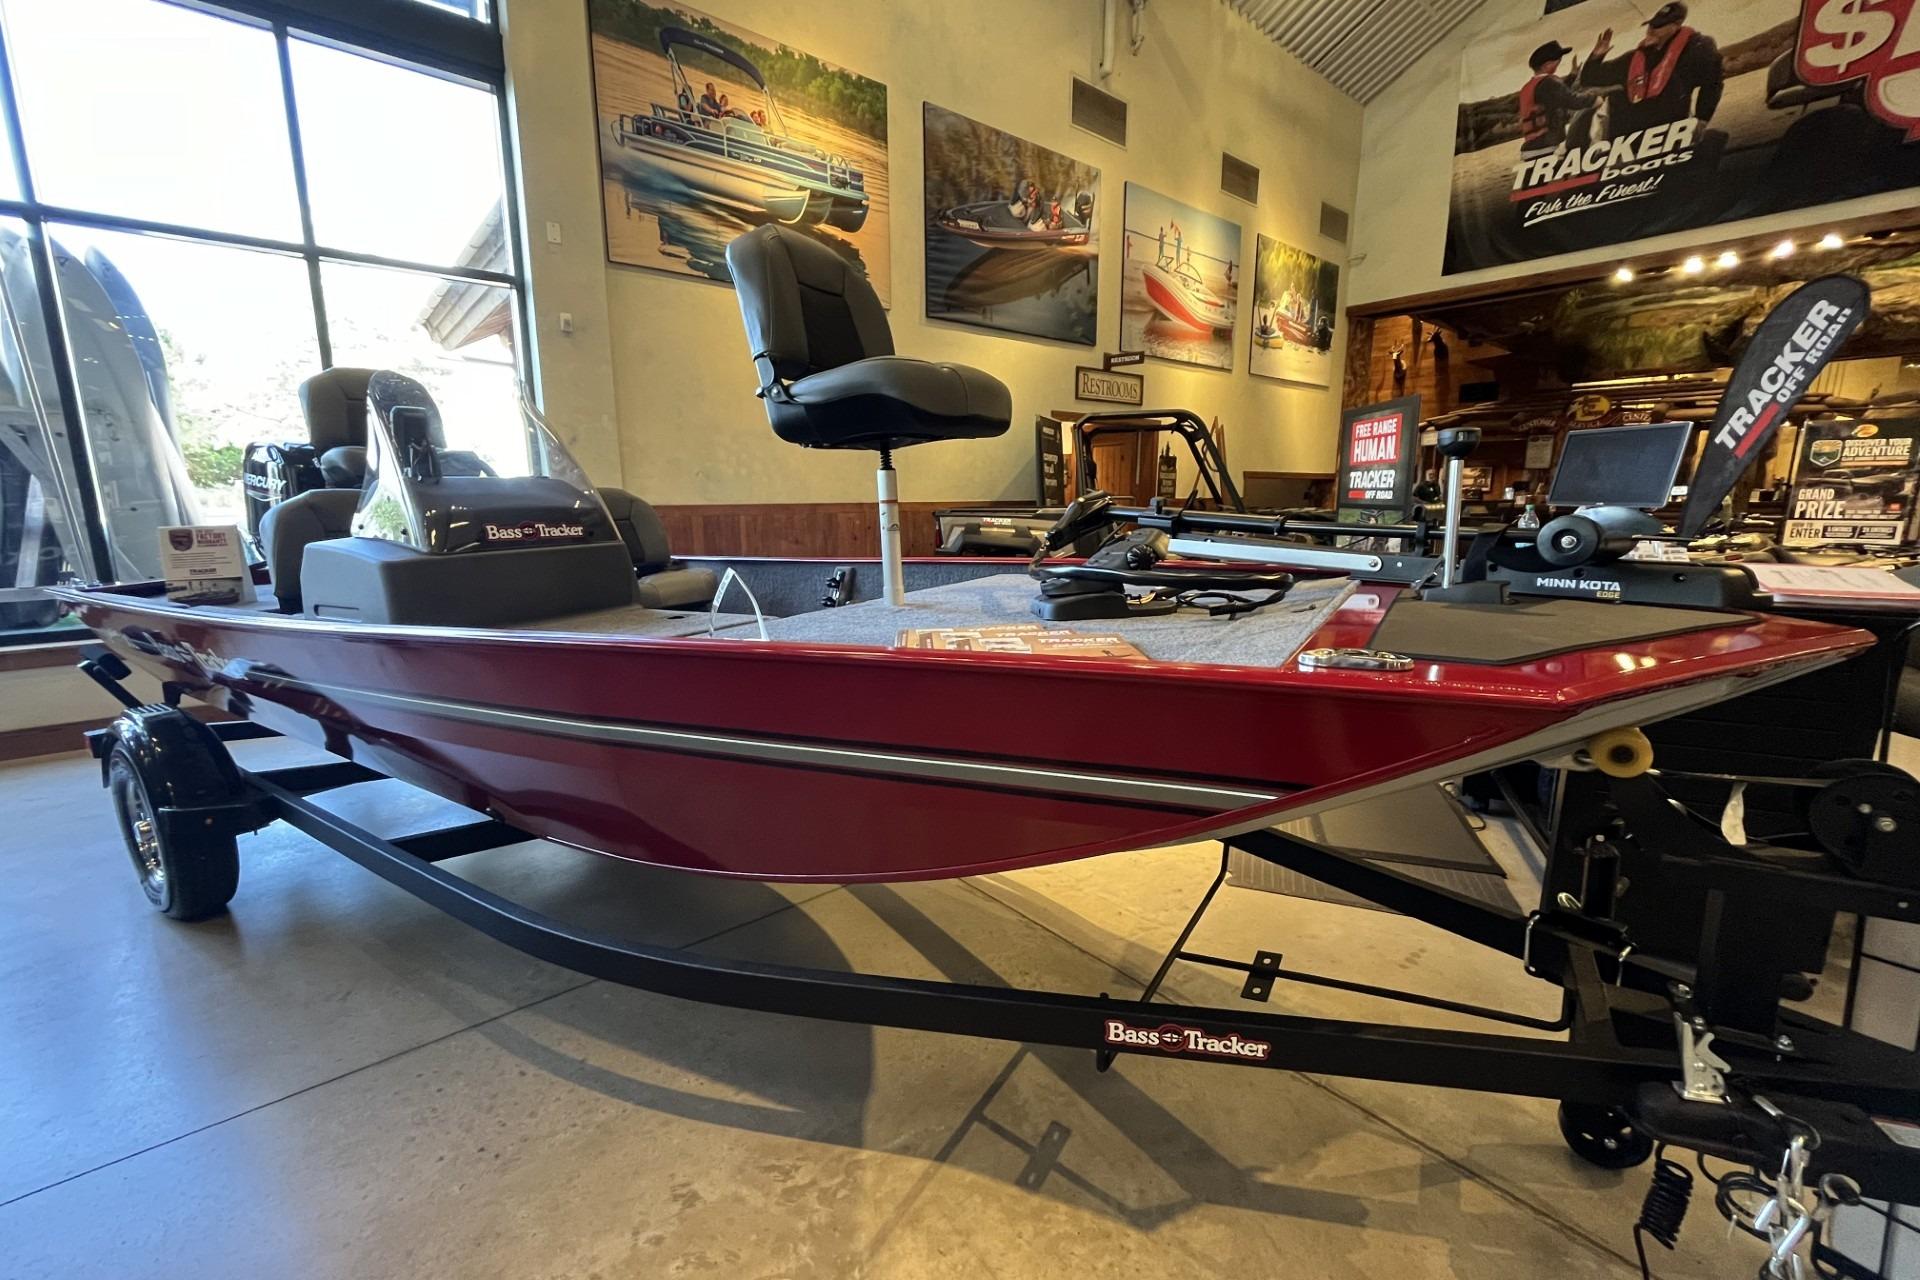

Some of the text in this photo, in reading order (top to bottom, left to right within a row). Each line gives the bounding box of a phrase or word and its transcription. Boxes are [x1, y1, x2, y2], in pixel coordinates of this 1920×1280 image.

[1512, 117, 1699, 190] TRACKER
[1600, 151, 1694, 181] boats
[1525, 174, 1665, 218] Fish the Finest!
[1714, 300, 1840, 449] TRACKER
[1776, 365, 1807, 403] OFF
[1082, 373, 1138, 399] RESTROOMS
[1356, 418, 1398, 438] FREE RANGE
[1353, 435, 1397, 462] HUMAN.
[1842, 446, 1911, 456] ADVENTURE
[1350, 469, 1396, 488] TRACKER
[1365, 490, 1393, 499] OFF ROAD
[1798, 488, 1835, 500] GRAND
[1794, 500, 1846, 518] PRIZE
[485, 523, 583, 540] Bass Tracker
[1790, 528, 1821, 538] ENTER
[1536, 577, 1621, 591] MINN KOTA
[1038, 636, 1121, 644] TRACKER
[1108, 1022, 1268, 1057] Bass Tracker
